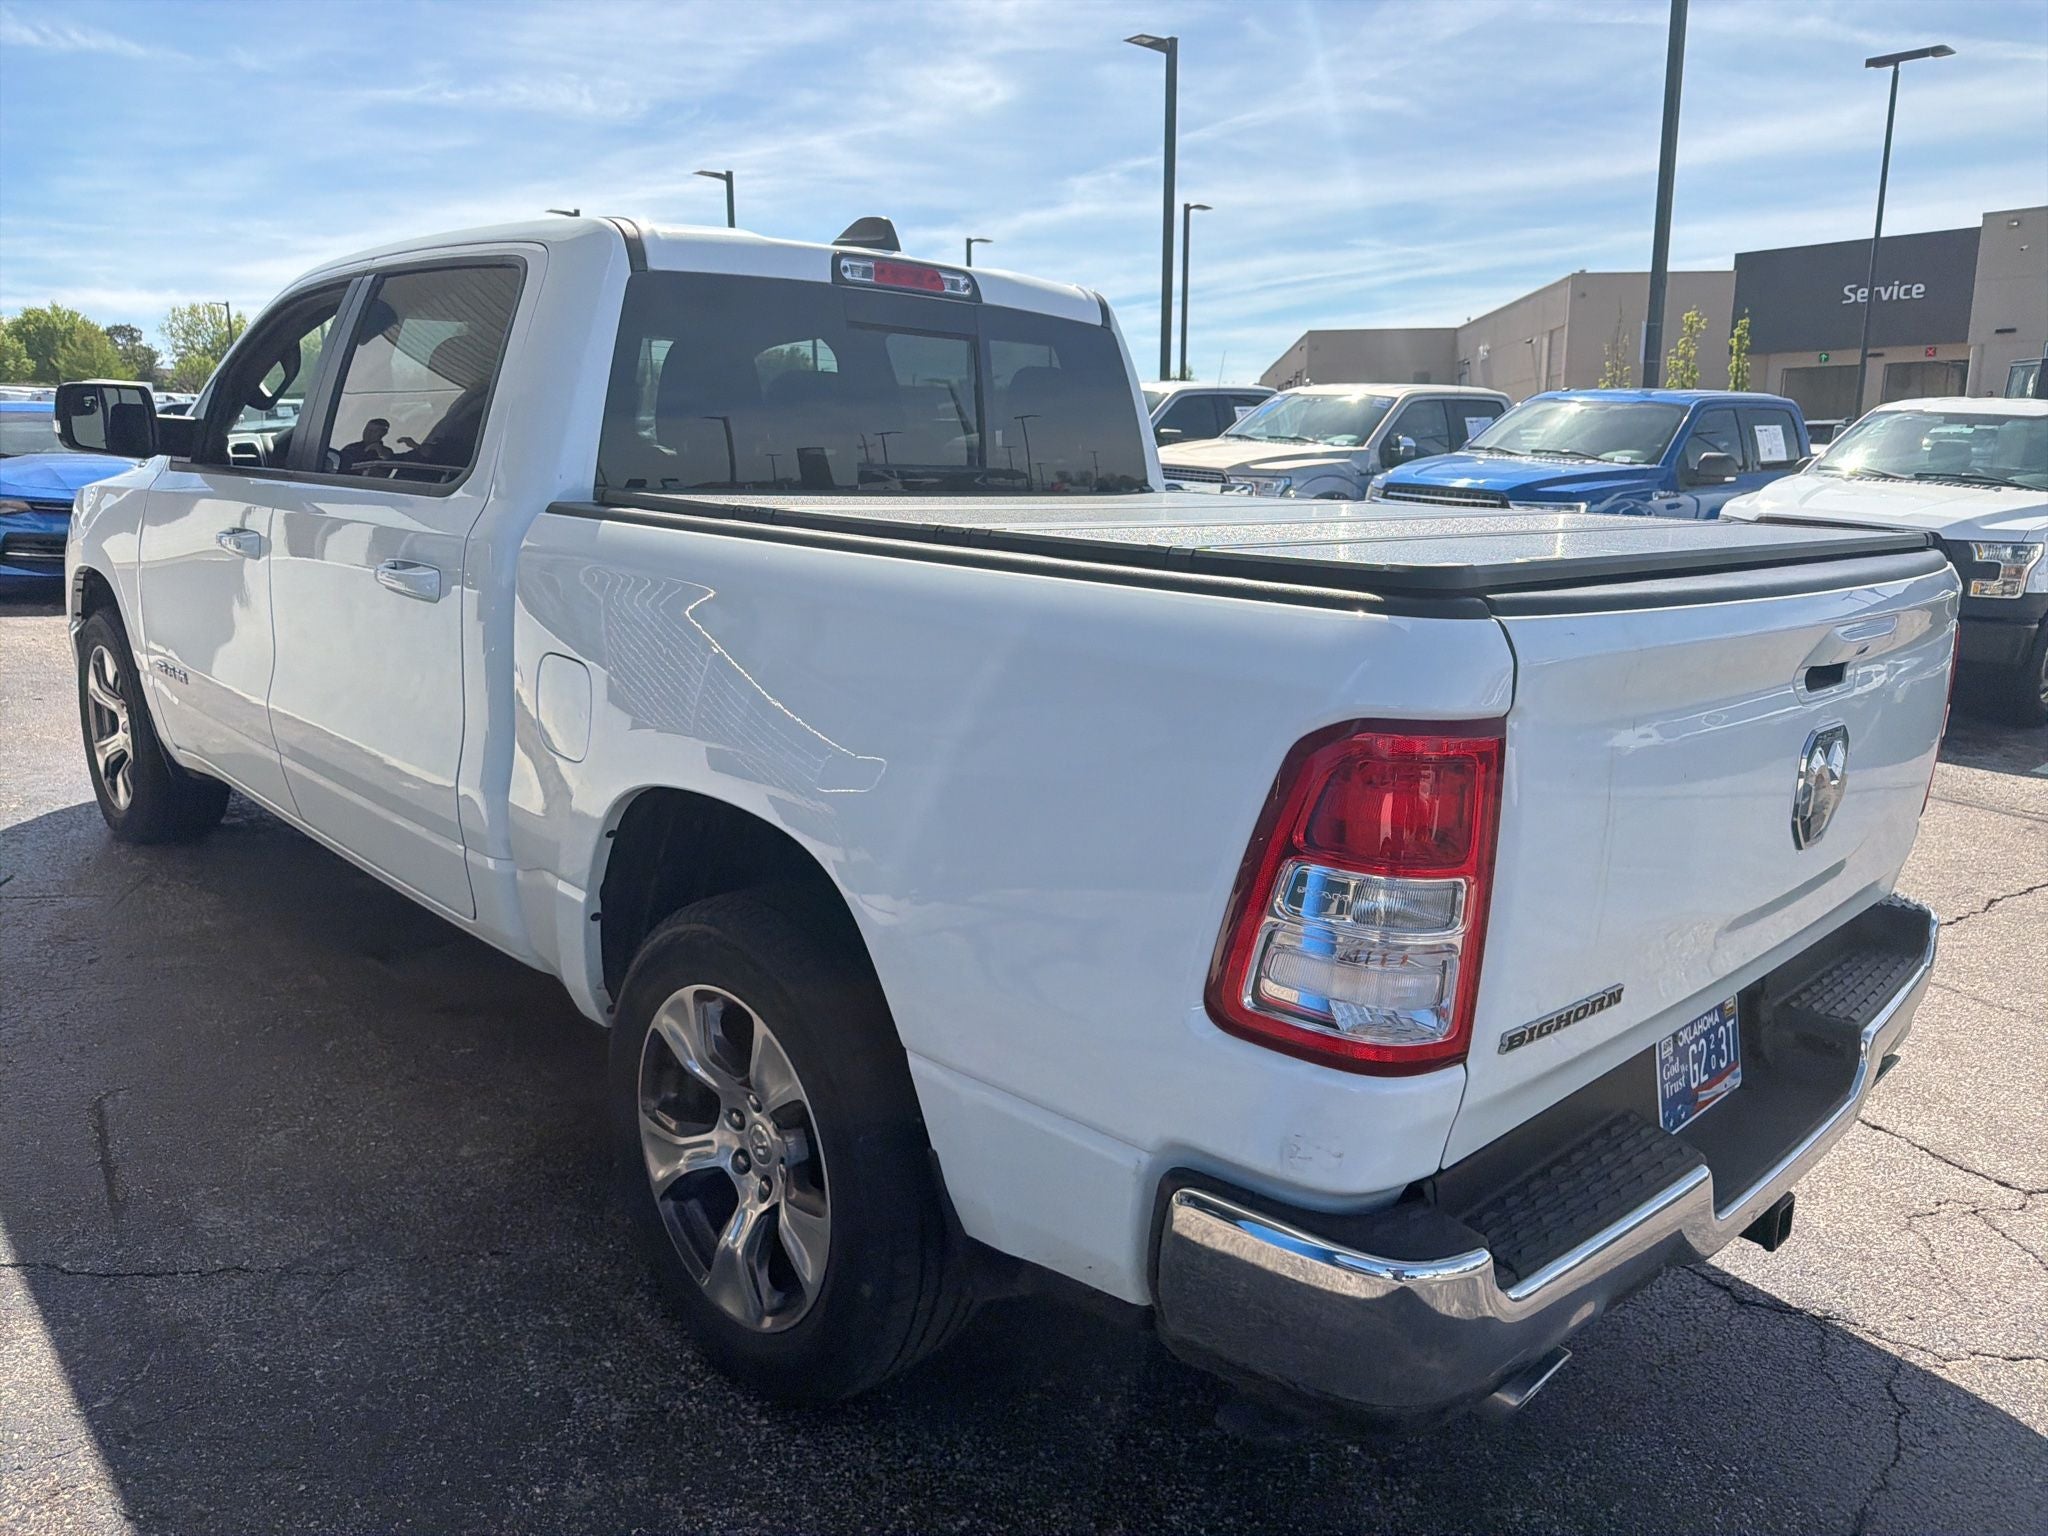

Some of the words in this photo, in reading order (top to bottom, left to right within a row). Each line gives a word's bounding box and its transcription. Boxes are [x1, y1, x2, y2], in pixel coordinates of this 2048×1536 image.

[1842, 280, 1926, 304] Service
[1498, 983, 1625, 1055] BIGHORN
[1677, 1009, 1720, 1047] OKLAHOMA
[1662, 1056, 1680, 1081] God
[1663, 1074, 1686, 1099] Trust
